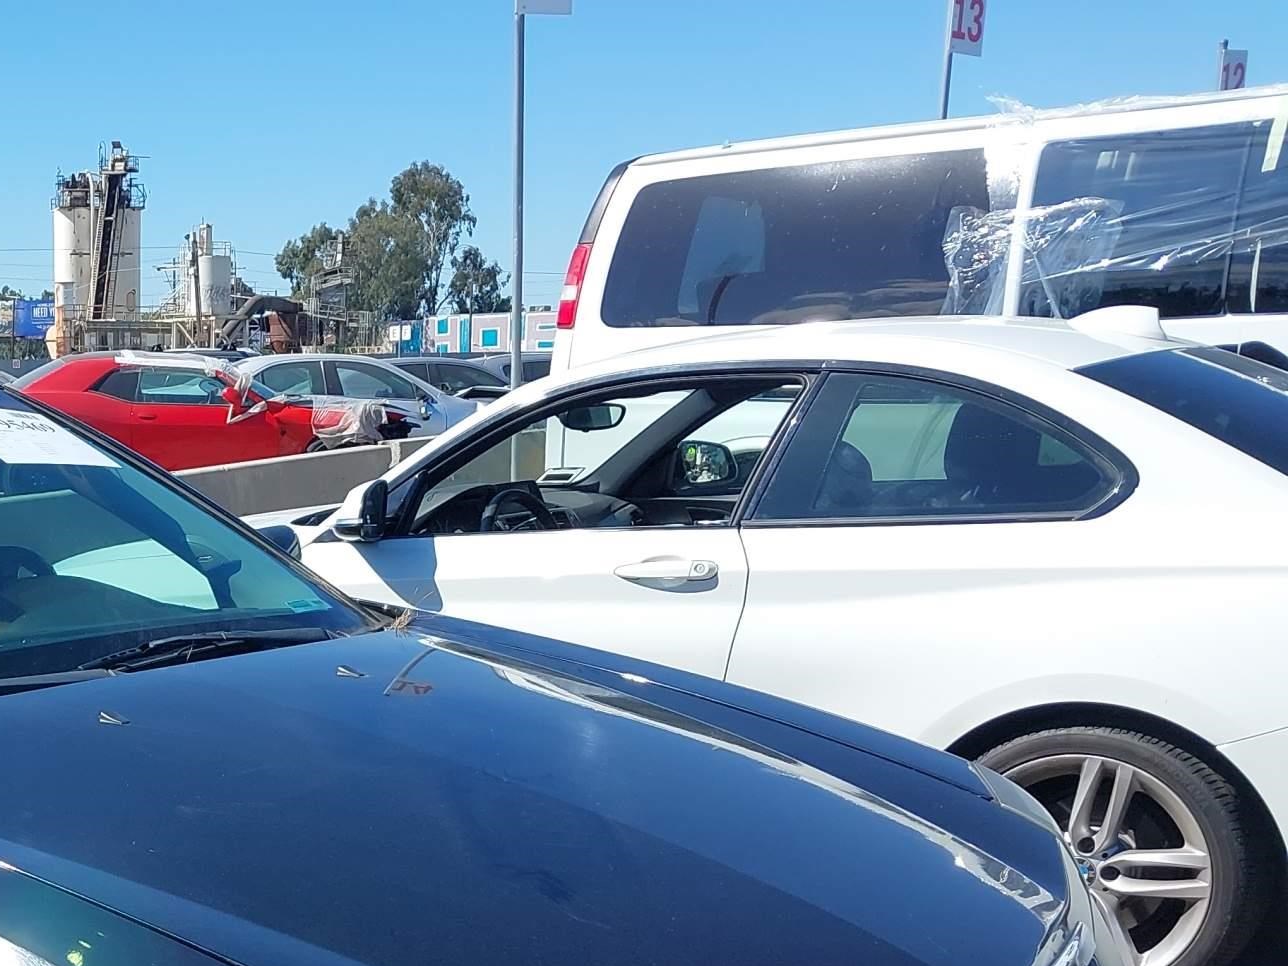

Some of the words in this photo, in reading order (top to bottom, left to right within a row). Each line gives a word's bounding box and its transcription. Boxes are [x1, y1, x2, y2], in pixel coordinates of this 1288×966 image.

[951, 0, 984, 42] 13
[1223, 62, 1245, 90] 12
[33, 307, 48, 318] NEED
